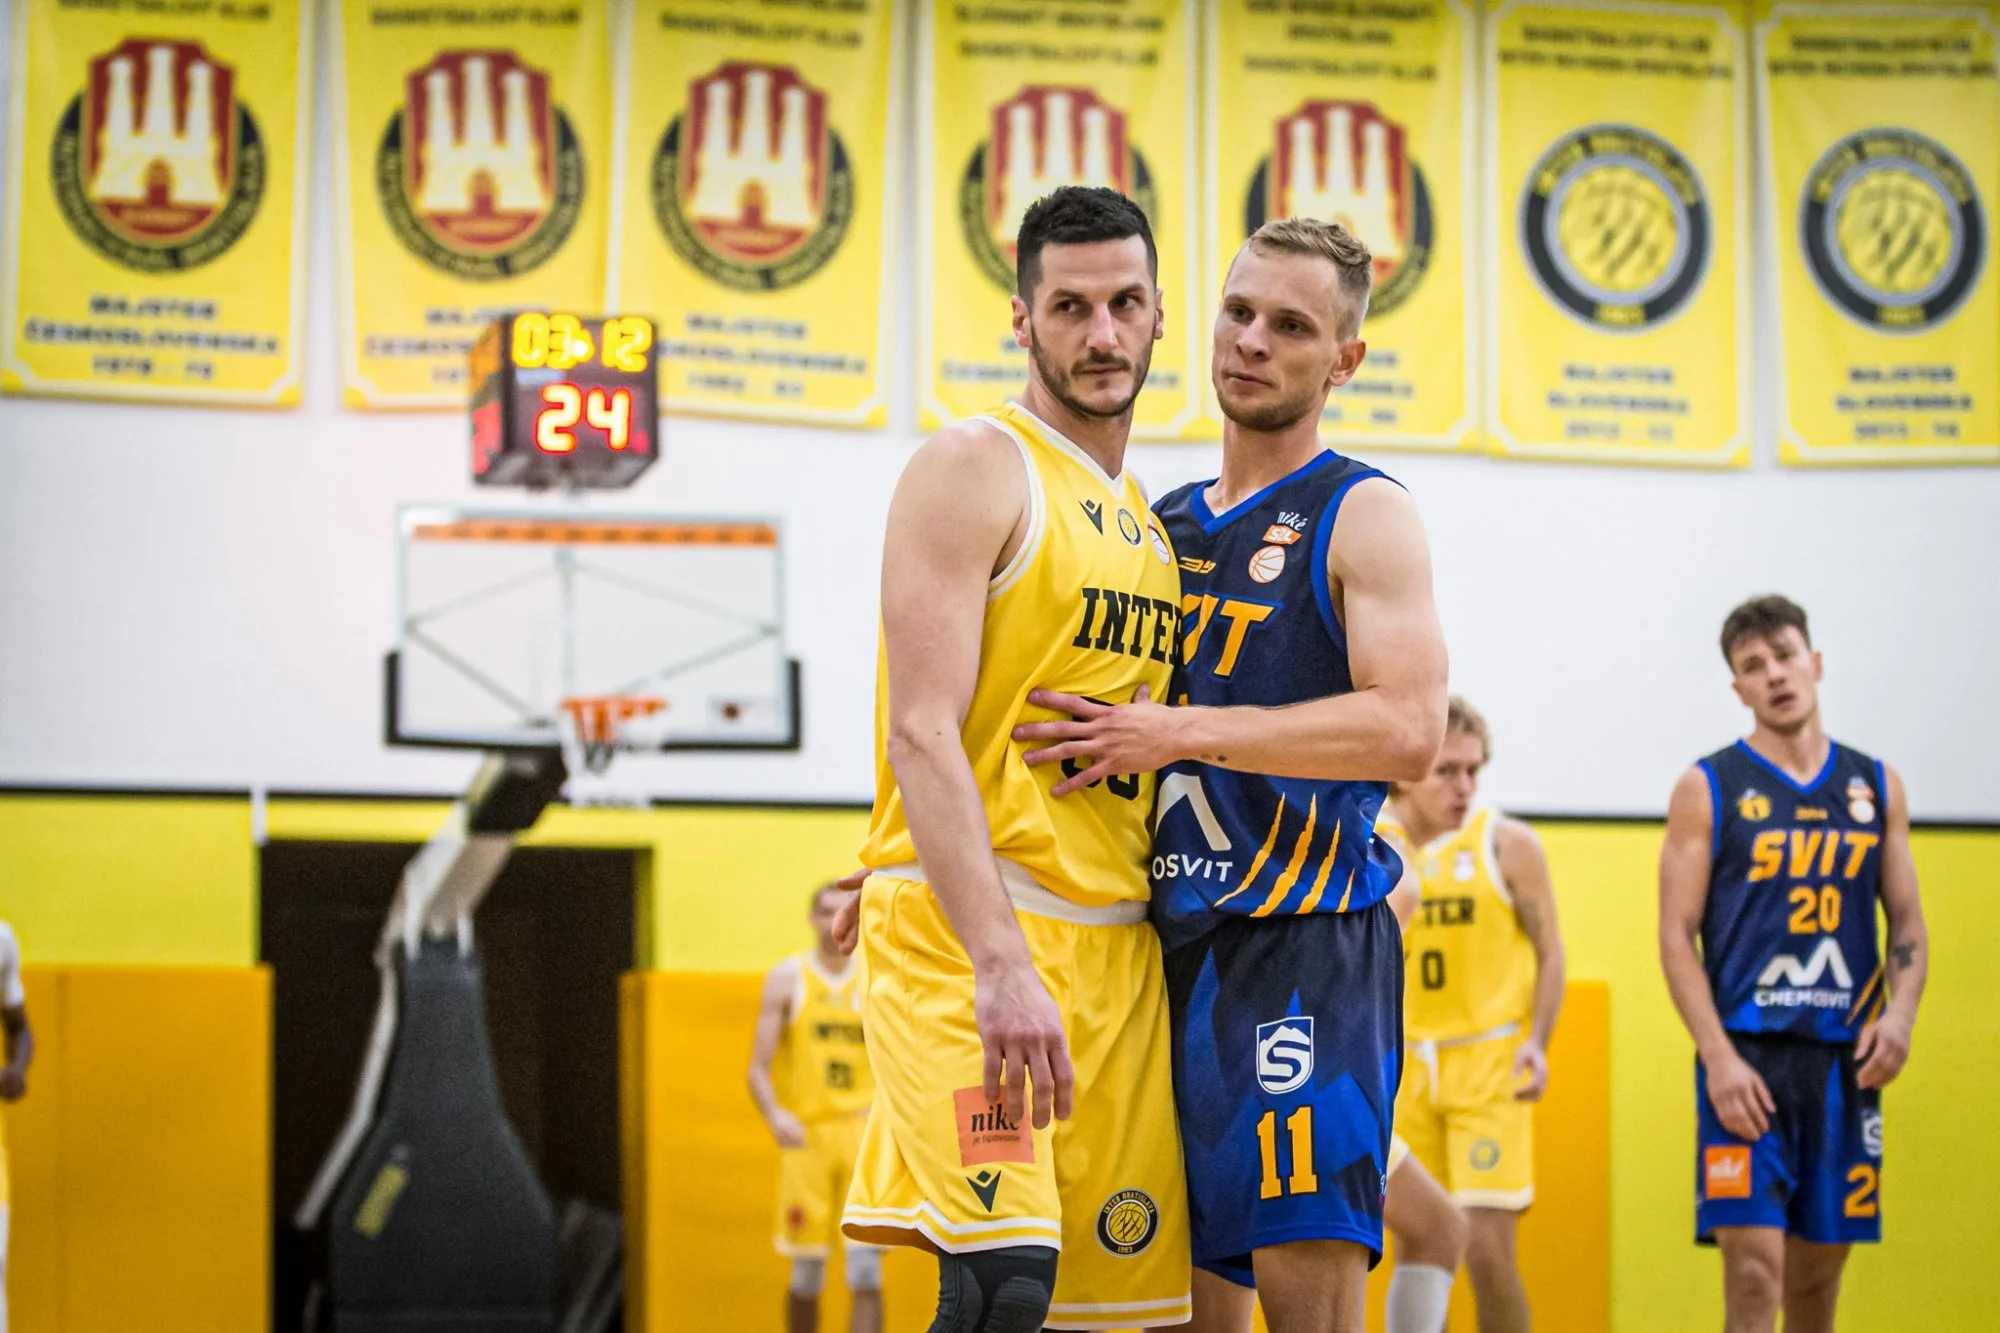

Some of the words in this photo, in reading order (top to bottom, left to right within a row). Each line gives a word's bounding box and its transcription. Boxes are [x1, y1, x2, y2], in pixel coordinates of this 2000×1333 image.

[535, 382, 633, 454] 24
[1071, 587, 1183, 664] INTER
[1747, 829, 1880, 883] SVIT
[1787, 885, 1842, 934] 20
[1257, 1105, 1318, 1200] 11
[1103, 1194, 1121, 1214] INTER
[1844, 1163, 1883, 1218] 2
